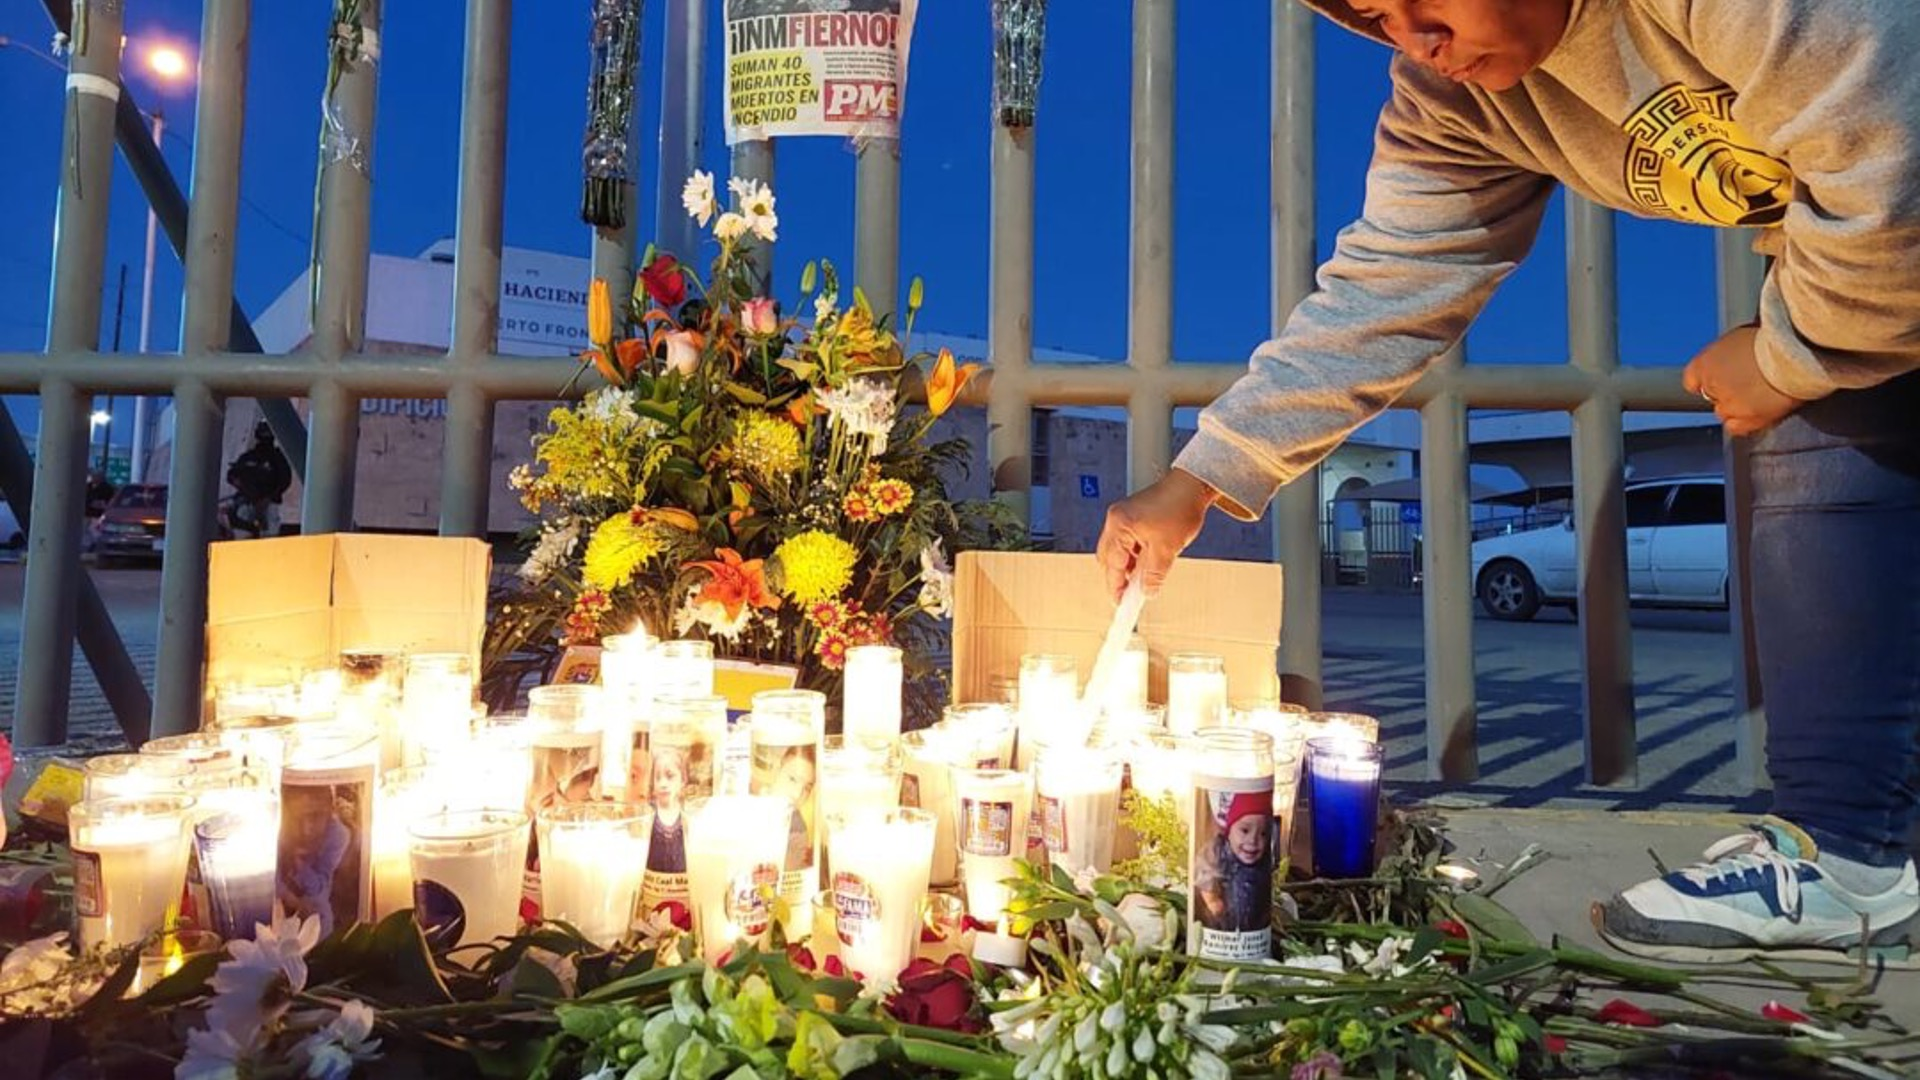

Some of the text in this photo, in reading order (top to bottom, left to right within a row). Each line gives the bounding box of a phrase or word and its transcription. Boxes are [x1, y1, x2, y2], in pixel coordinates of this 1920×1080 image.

[730, 13, 898, 55] ¡INMFIERNO!
[731, 56, 802, 78] SUMAN 40
[731, 72, 811, 94] MIGRANTES
[731, 89, 819, 111] MUERTOS EN
[735, 107, 797, 126] NCENDIO
